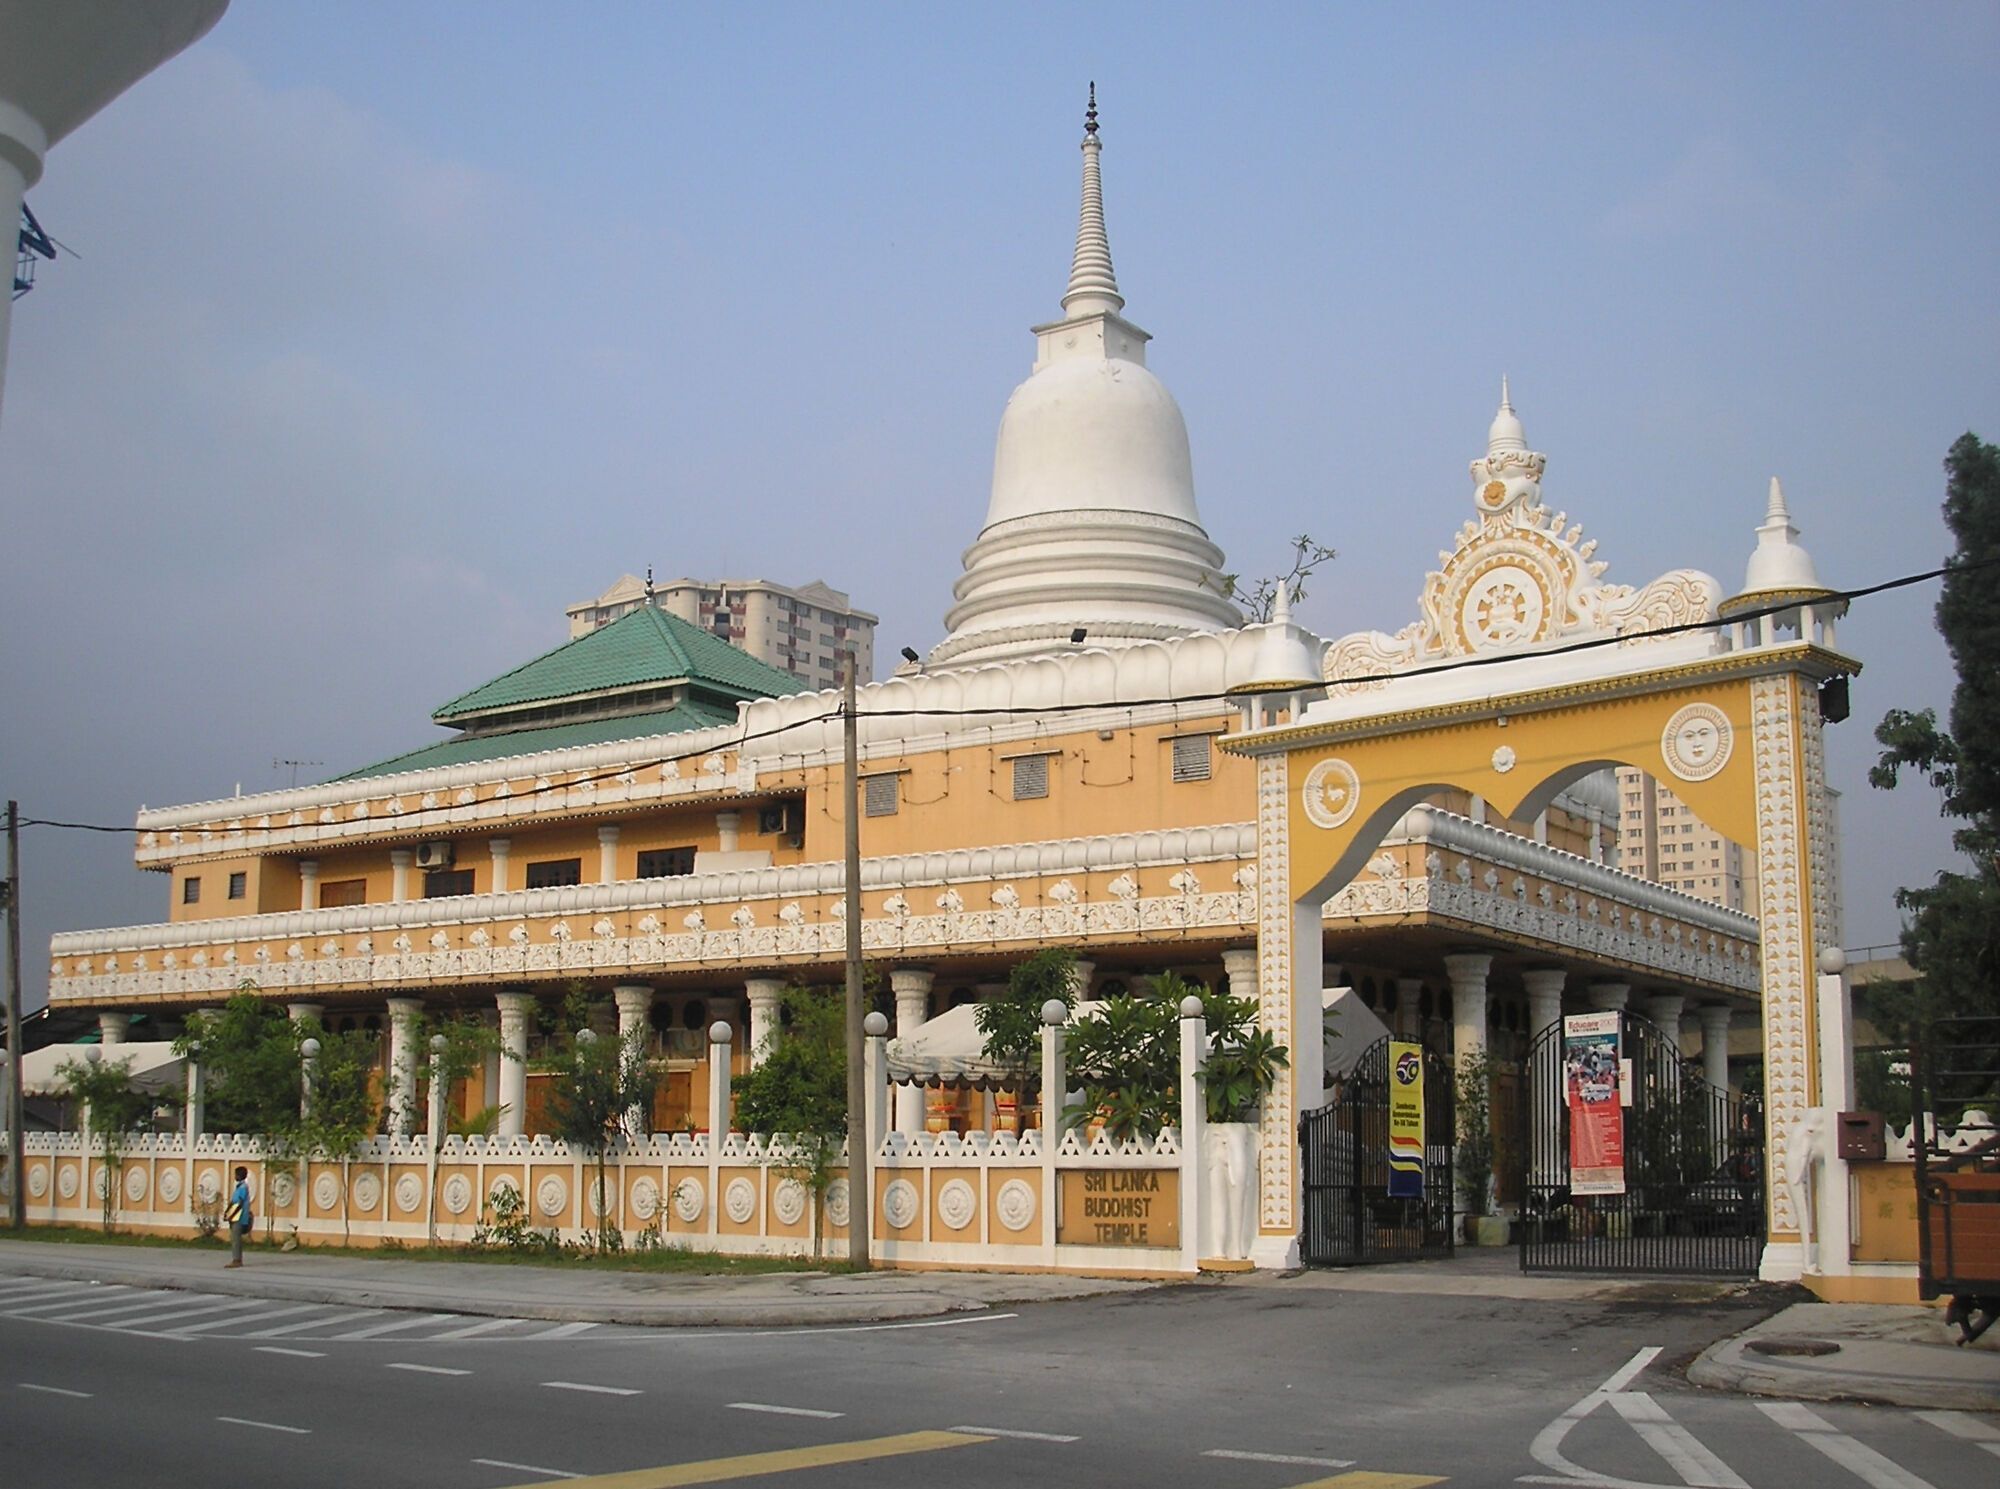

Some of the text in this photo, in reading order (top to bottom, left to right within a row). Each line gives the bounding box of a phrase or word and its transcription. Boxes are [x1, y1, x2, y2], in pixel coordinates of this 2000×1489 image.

[1085, 1171, 1159, 1192] SRI LANKA
[1085, 1197, 1152, 1217] BUDDHIST
[1094, 1223, 1148, 1245] TEMPLE
